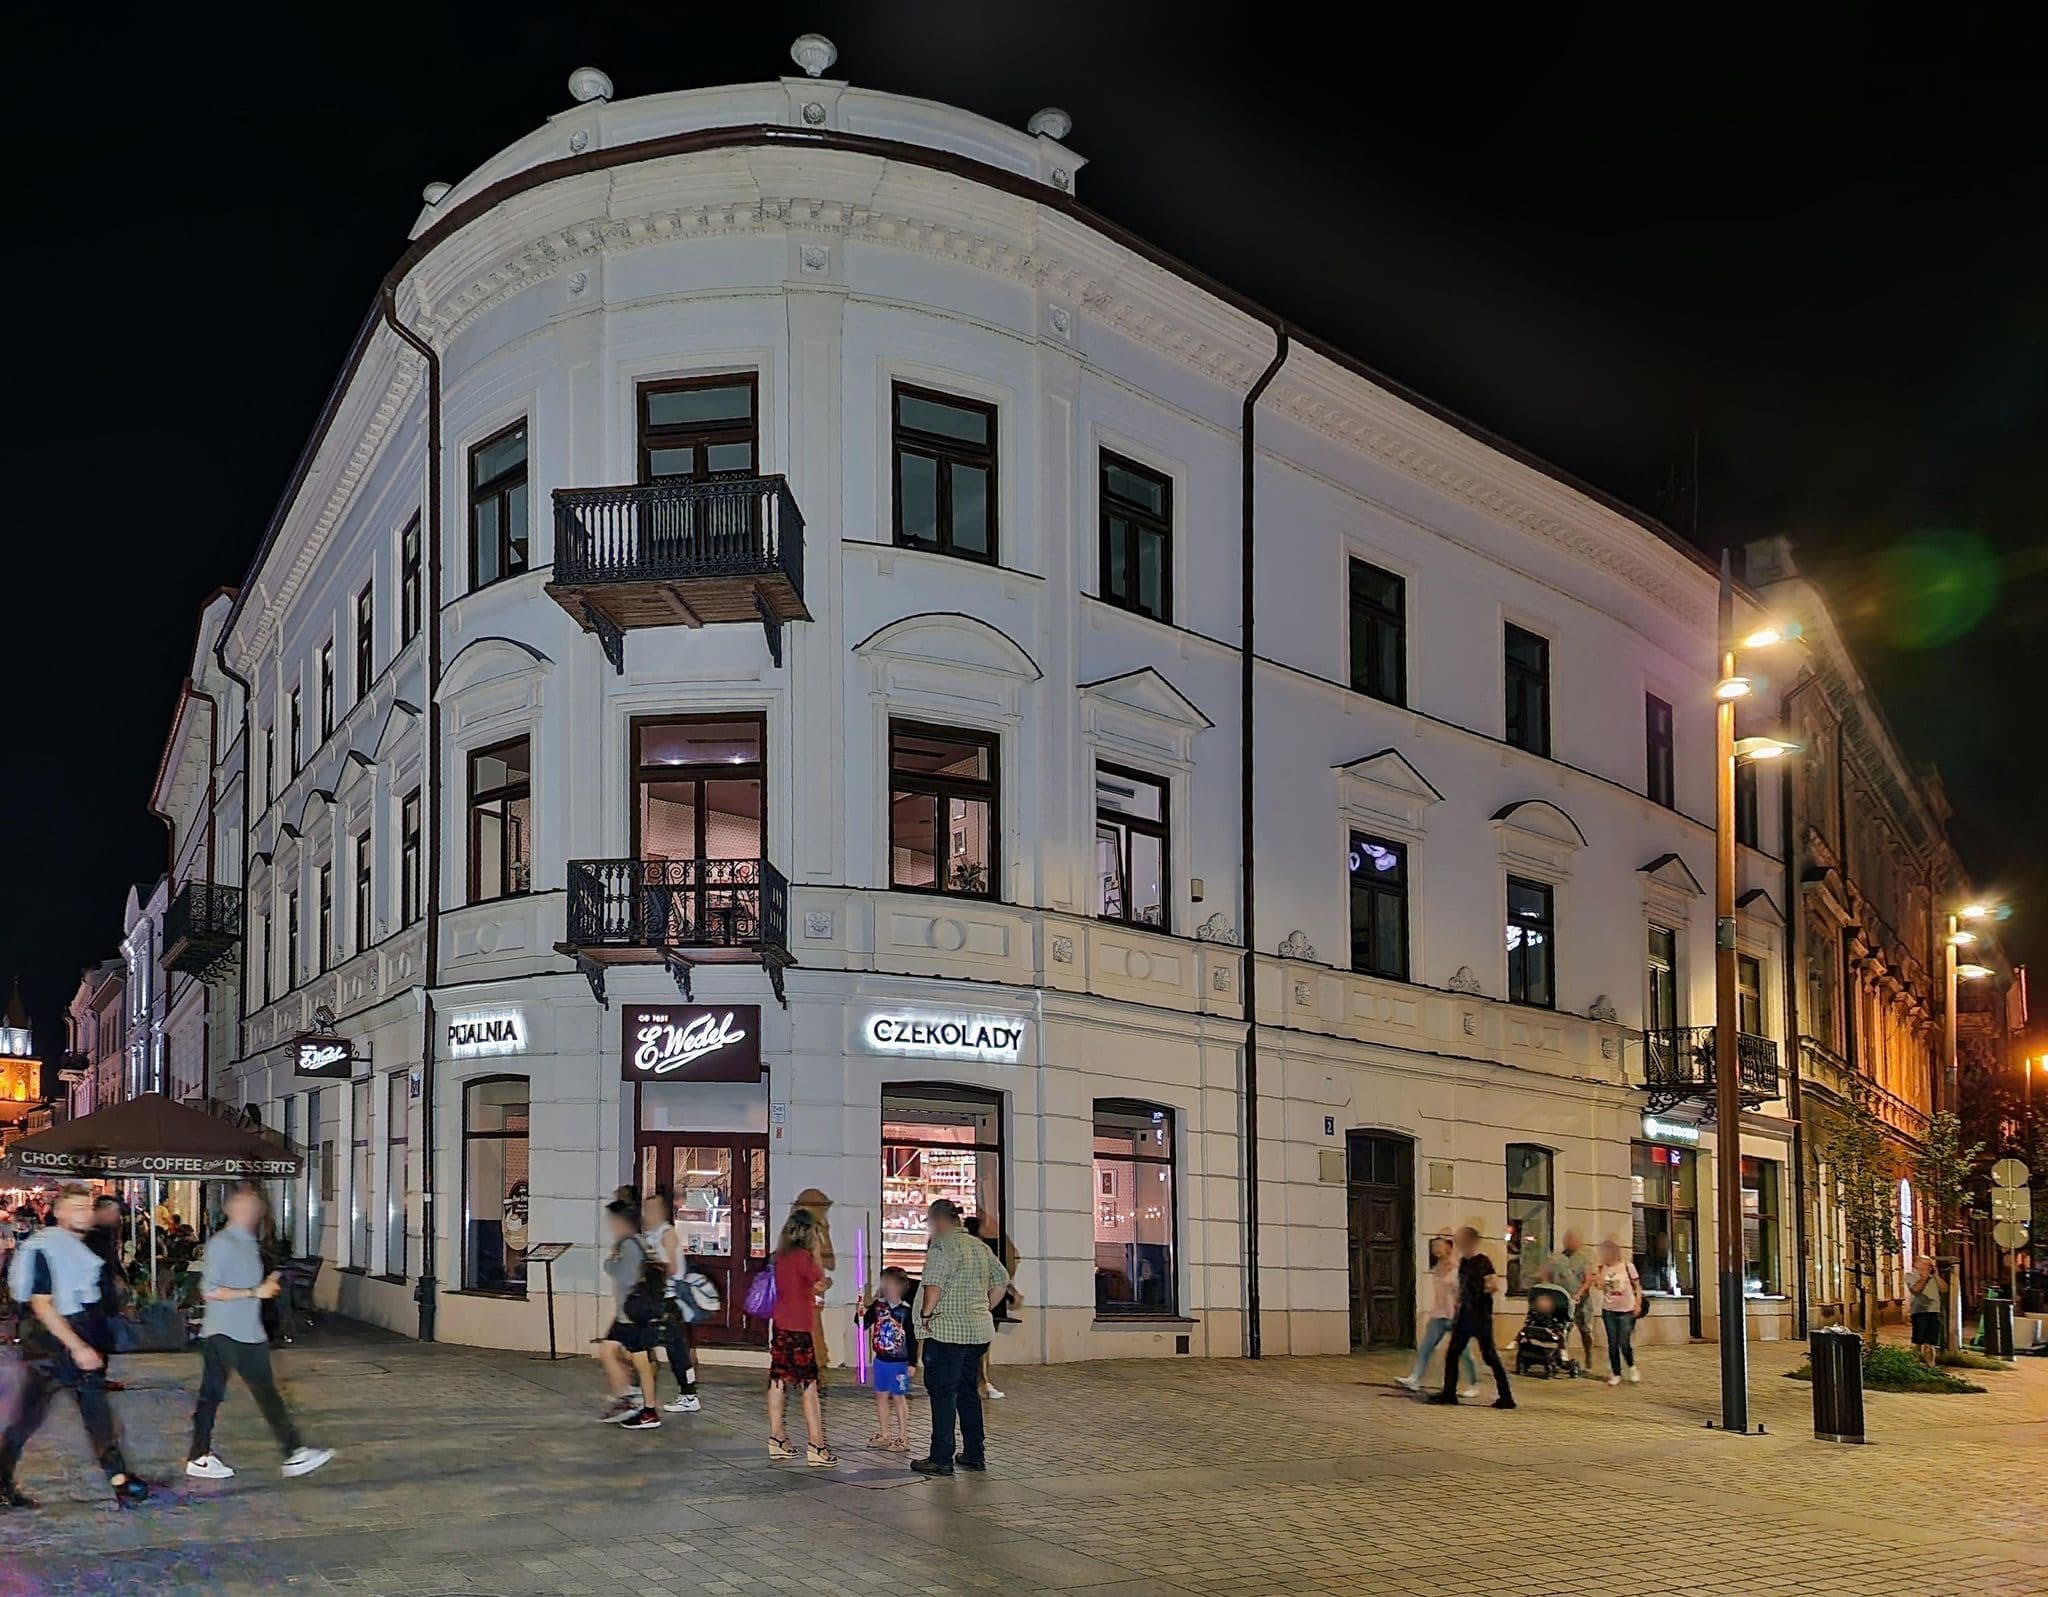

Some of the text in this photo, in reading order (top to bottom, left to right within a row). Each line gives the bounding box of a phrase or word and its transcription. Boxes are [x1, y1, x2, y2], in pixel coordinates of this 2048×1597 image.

[447, 1020, 518, 1046] PIJALNIA
[873, 1019, 1022, 1050] CZEKOLADY
[1327, 1121, 1333, 1133] 2
[142, 1157, 202, 1171] COFFEE
[225, 1159, 296, 1174] DESSERTS
